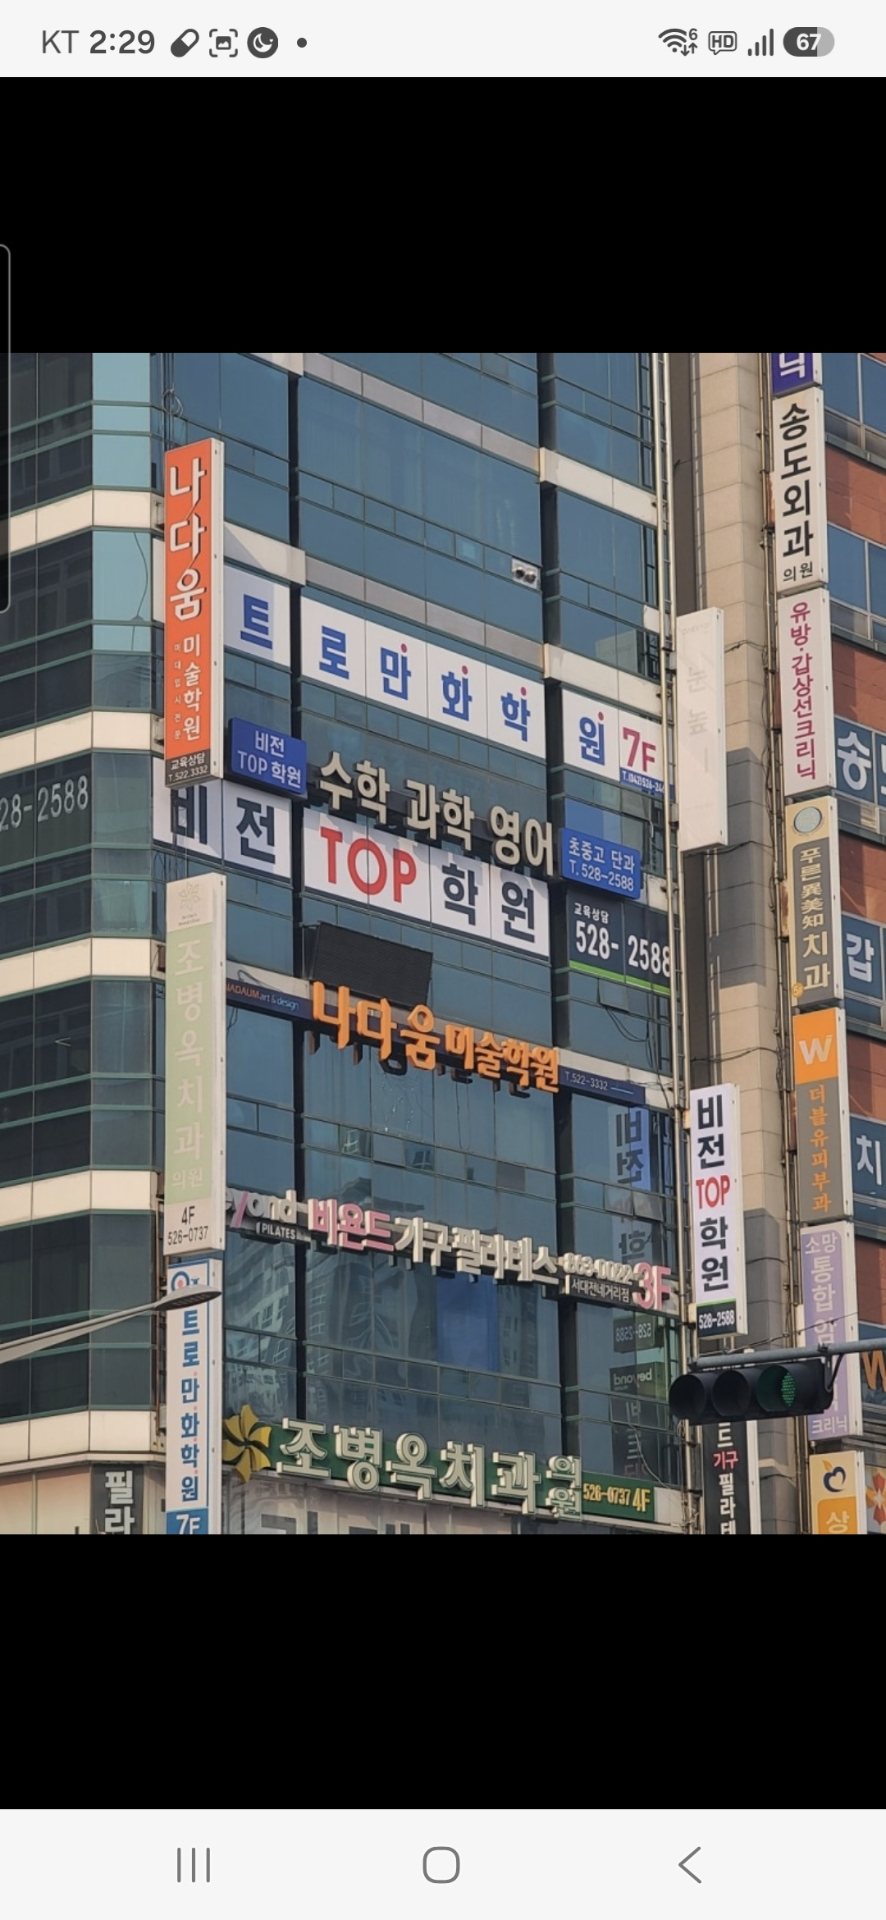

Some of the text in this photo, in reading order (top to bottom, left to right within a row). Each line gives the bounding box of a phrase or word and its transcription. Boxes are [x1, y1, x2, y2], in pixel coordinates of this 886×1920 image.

[779, 402, 814, 558] 송도외과
[169, 457, 207, 620] 나다움
[783, 562, 814, 582] 의원
[183, 634, 202, 741] 미술학원
[170, 752, 206, 771] 교육상담
[254, 730, 285, 758] 비전
[622, 726, 657, 773] 7F
[837, 731, 886, 795] 송
[237, 750, 301, 789] TOP 학원
[319, 752, 554, 876] 수학 과학 영어
[171, 786, 536, 944] 비전 TOP 학원
[569, 836, 635, 875] 초중고 단과
[573, 902, 609, 924] 교육상담
[846, 933, 875, 982] 갑
[175, 940, 204, 1160] 조병옥치과
[313, 981, 560, 1094] 나다움 미술학원
[798, 1035, 833, 1065] W
[565, 1070, 608, 1091] T.522-3332
[808, 1084, 832, 1214] 더블유피부과
[855, 1134, 882, 1186] 치
[171, 1167, 203, 1189] 의원
[696, 1095, 730, 1292] 비전 TOP 학원
[181, 1206, 195, 1225] 4F
[226, 1188, 297, 1228] yond
[168, 1226, 209, 1245] 526-0737
[261, 1221, 296, 1240] PILATES
[804, 1231, 838, 1255] 소망
[571, 1278, 630, 1303] 서대전네거리점
[632, 1261, 672, 1310] 3F
[698, 1308, 735, 1329] 528-2588
[181, 1309, 200, 1502] 트로만화학원
[811, 1414, 848, 1434] 크리닉
[276, 1417, 651, 1520] 조병옥치과 의원 526-0737 4F
[713, 1450, 739, 1470] 기구
[175, 1513, 201, 1534] 7F
